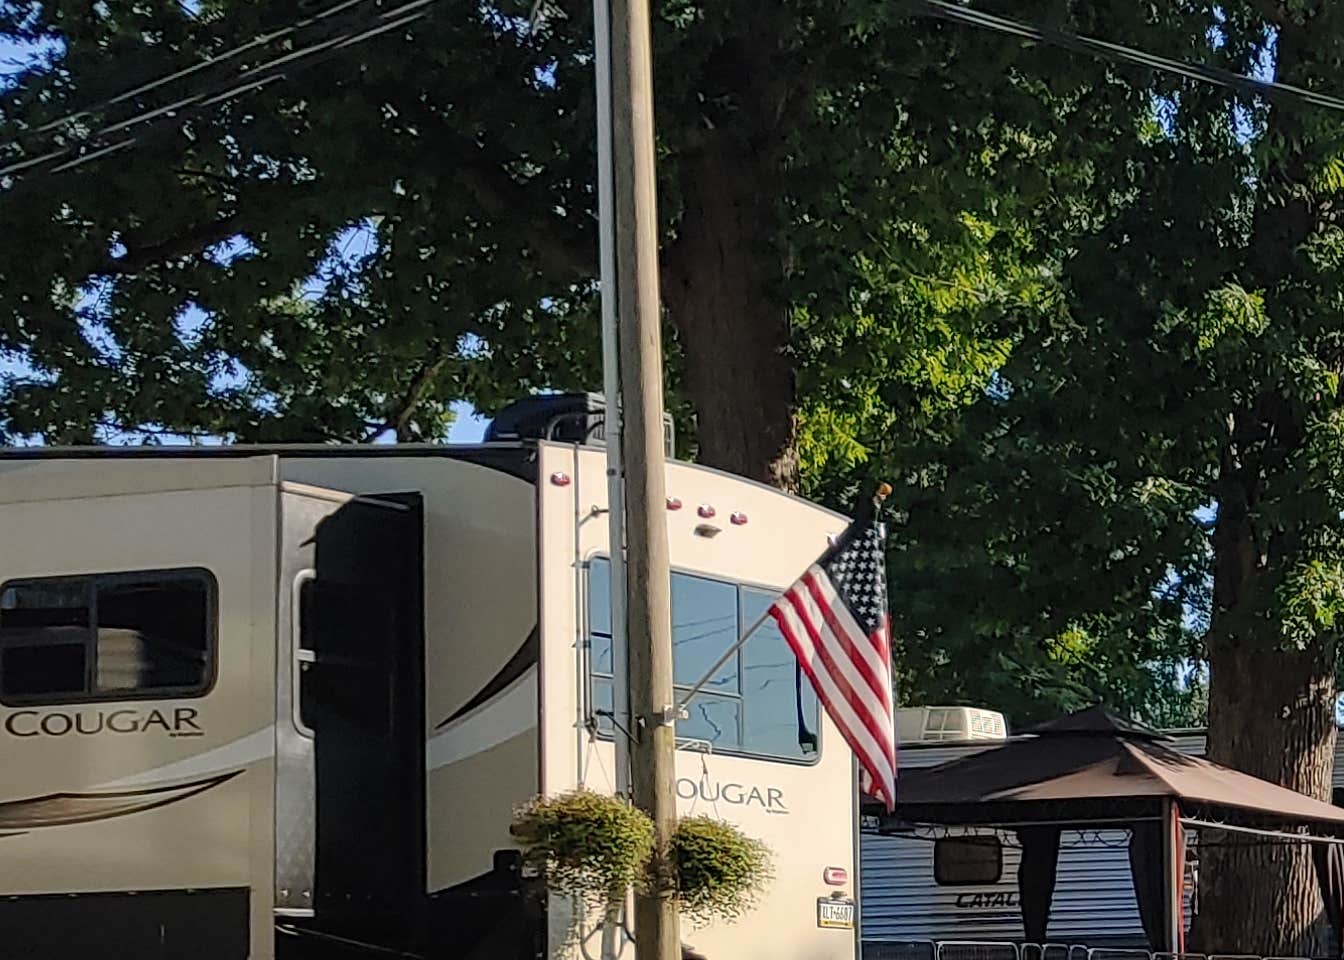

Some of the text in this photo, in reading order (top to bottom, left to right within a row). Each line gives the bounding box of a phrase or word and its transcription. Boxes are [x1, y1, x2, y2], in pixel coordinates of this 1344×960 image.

[5, 708, 202, 737] COUGAR
[676, 778, 788, 809] OUGAR
[955, 893, 1018, 908] CATAL
